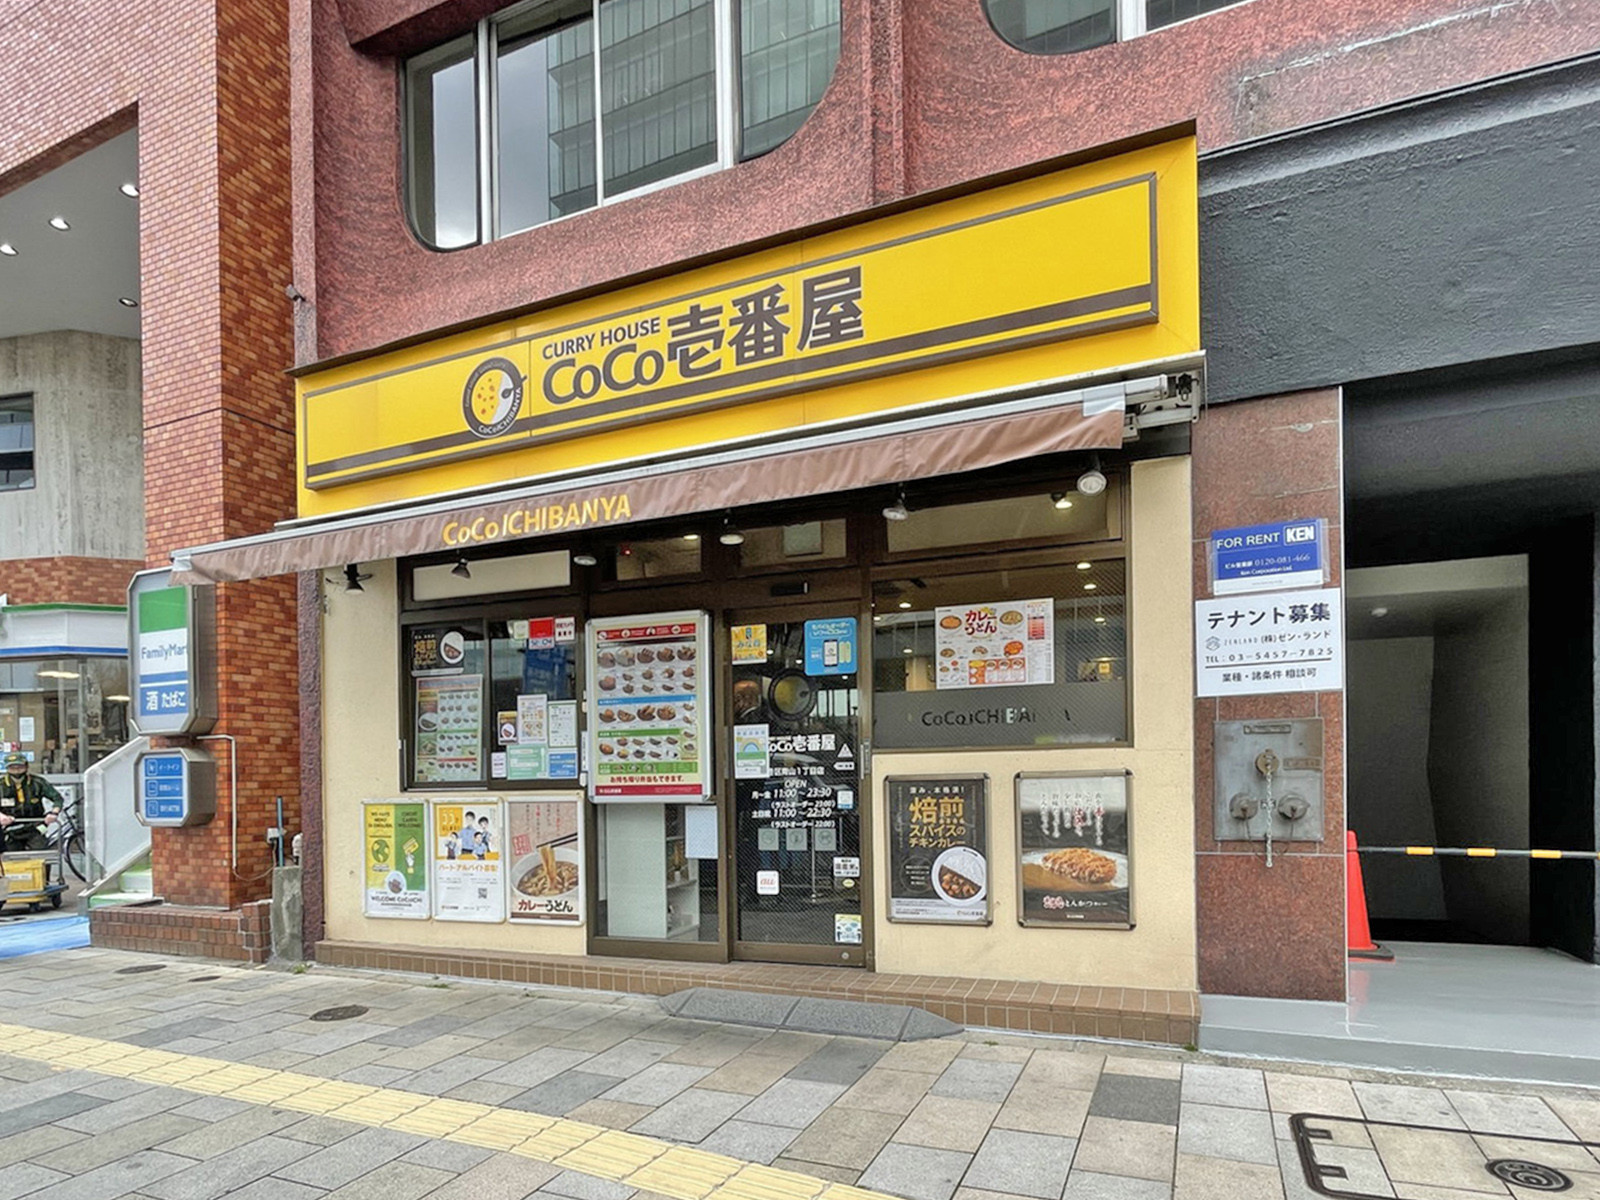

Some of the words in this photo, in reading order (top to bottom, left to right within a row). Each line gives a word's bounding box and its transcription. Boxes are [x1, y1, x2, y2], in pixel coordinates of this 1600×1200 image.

[542, 265, 864, 405] CoCo壱番屋
[542, 333, 596, 360] CURRY
[600, 317, 661, 347] HOUSE
[1216, 536, 1243, 549] FOR
[1246, 532, 1281, 546] RENT
[1286, 525, 1315, 543] KEN
[965, 609, 998, 623] カレー
[1206, 602, 1331, 630] テナント募集
[964, 621, 998, 636] うどん
[146, 690, 159, 711] 酒
[161, 690, 187, 708] たばこ
[769, 733, 836, 752] oCo壱番屋
[784, 779, 808, 789] OPEN
[908, 796, 966, 825] 焙煎
[909, 824, 967, 837] スパイスの
[908, 837, 966, 848] チキンカレー
[518, 899, 574, 913] カレーうどん
